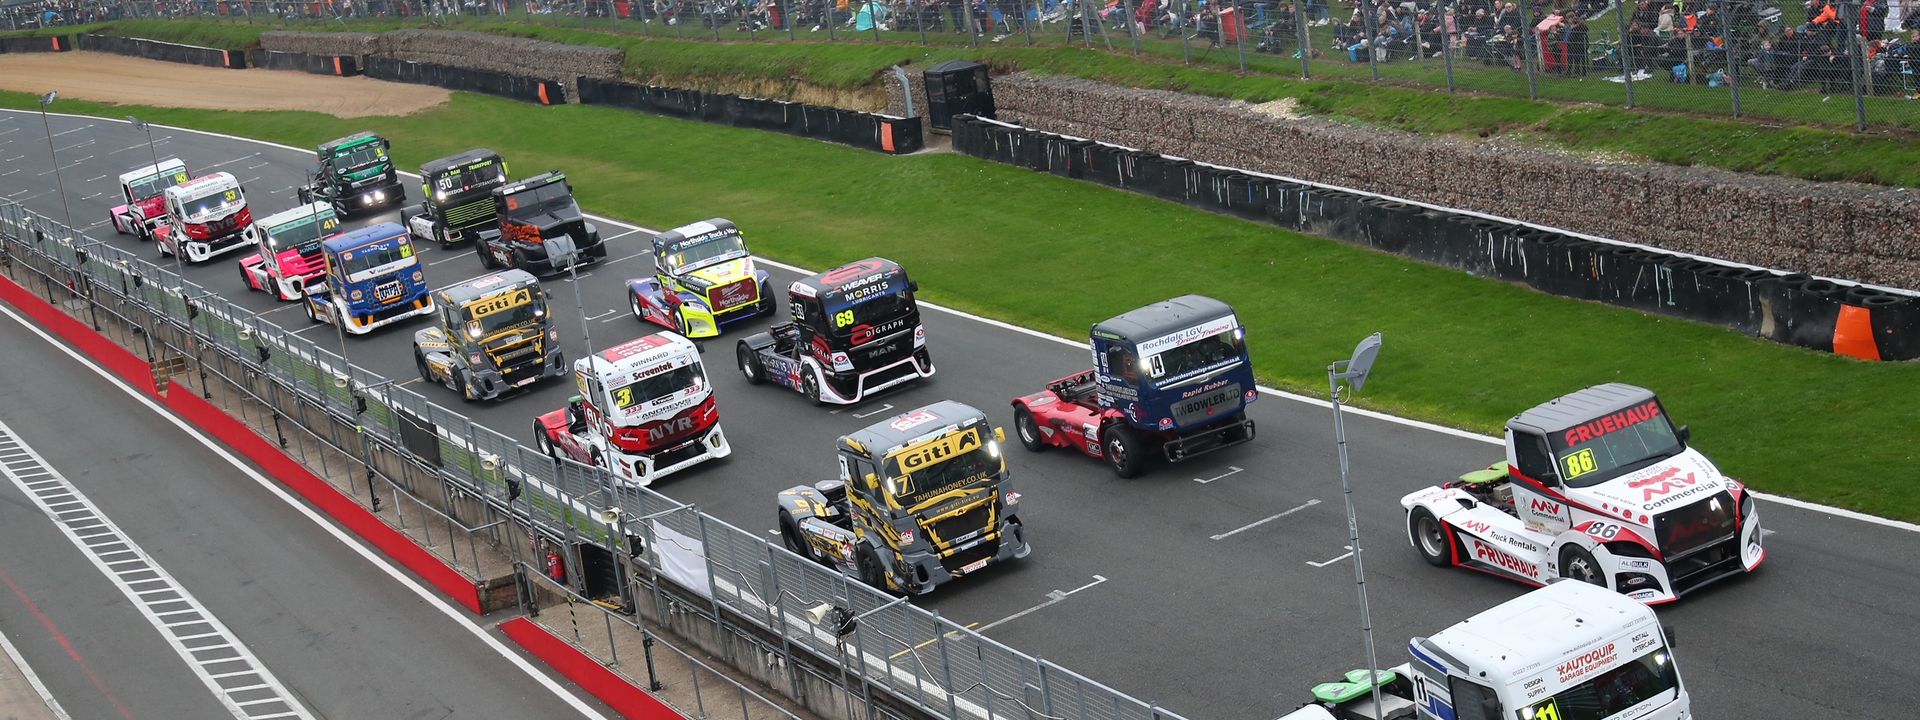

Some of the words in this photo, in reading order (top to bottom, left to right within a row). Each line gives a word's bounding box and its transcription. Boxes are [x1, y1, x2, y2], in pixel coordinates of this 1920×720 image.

[439, 178, 452, 190] 50
[225, 190, 236, 201] 33
[323, 218, 336, 229] 41
[841, 273, 883, 292] WEAVER
[845, 281, 889, 302] MORRIS
[475, 298, 509, 315] Giti
[852, 291, 886, 305] LUBRICANTS
[835, 310, 855, 328] 69
[866, 320, 904, 338] DIGRAPH
[1175, 334, 1198, 347] Driver
[1200, 323, 1230, 338] Training
[1142, 332, 1184, 351] Rochdale
[1186, 326, 1203, 338] LGV
[630, 352, 669, 368] WINNARD
[869, 344, 897, 358] MAN
[632, 361, 674, 381] Screentek
[1149, 355, 1163, 375] 14
[617, 388, 630, 407] 3
[684, 385, 700, 395] 333
[1182, 385, 1204, 399] Rapid
[1203, 379, 1229, 393] Rubber
[624, 405, 643, 415] 333
[649, 416, 694, 442] NYR
[904, 442, 951, 468] Giti
[1567, 450, 1593, 477] 86
[896, 476, 909, 495] 7
[914, 471, 988, 503] TAHUNAHONEY.CO.UK
[1643, 480, 1719, 511] Commercial
[1531, 509, 1565, 523] Commercial
[1587, 521, 1619, 539] 86
[1490, 531, 1507, 543] Truck
[1508, 537, 1537, 552] Rentals
[1631, 632, 1649, 643] INSTALL
[1632, 638, 1656, 654] AFTERCARE
[1565, 643, 1616, 673] AUTOQUIP
[1559, 669, 1585, 684] GARAGE
[1585, 653, 1618, 675] EQUIPMENT
[1413, 674, 1428, 703] 11
[1523, 676, 1544, 690] DESIGN
[1527, 686, 1547, 699] SUPPLY
[1535, 702, 1560, 720] 11
[1622, 702, 1652, 719] EDITION
